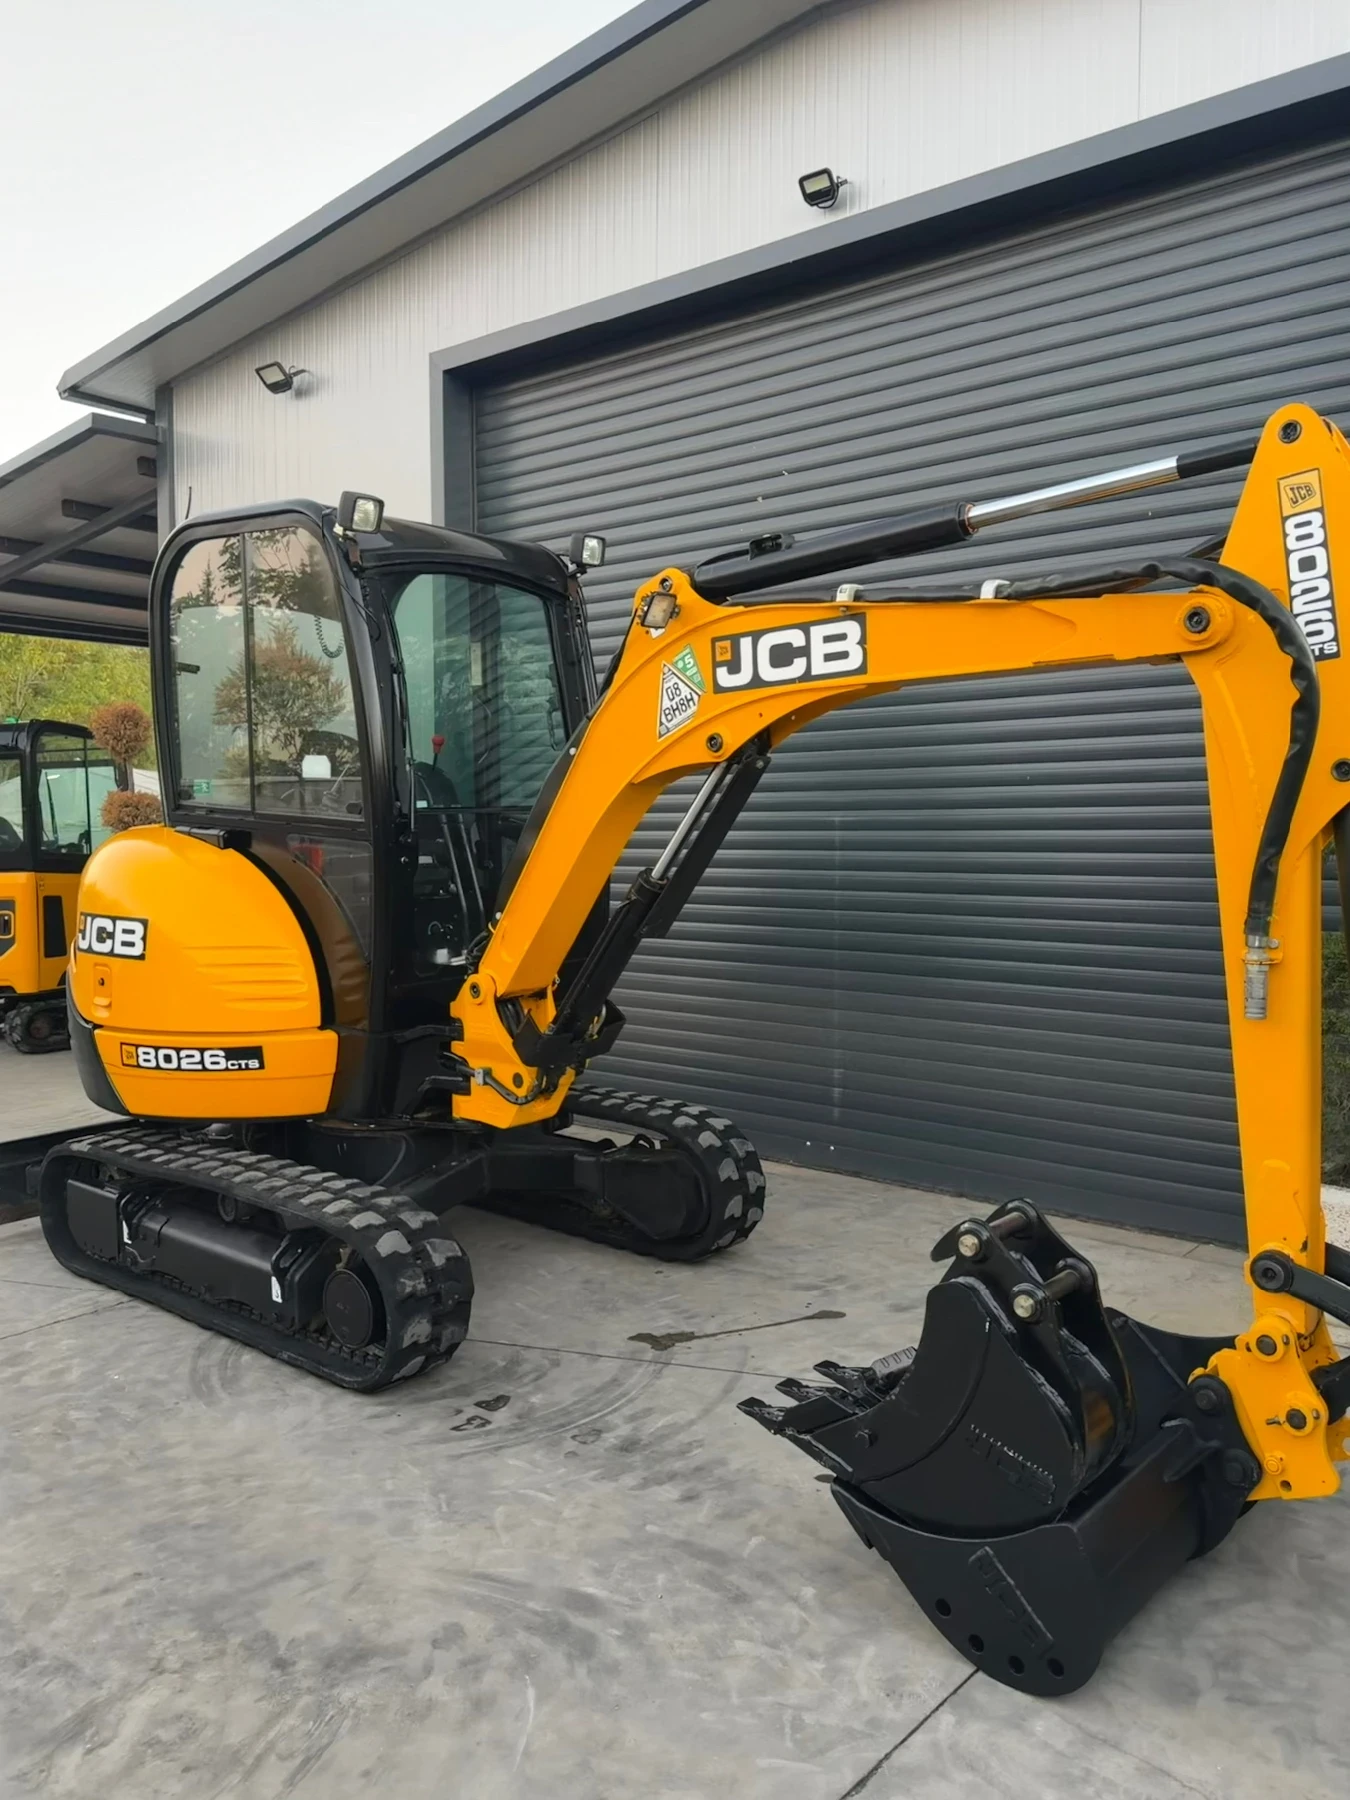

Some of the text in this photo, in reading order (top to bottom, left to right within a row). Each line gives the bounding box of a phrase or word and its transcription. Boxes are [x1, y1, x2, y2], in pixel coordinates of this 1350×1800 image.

[1289, 486, 1313, 505] JCB
[1285, 511, 1335, 645] 8026
[716, 620, 864, 688] JCB
[663, 692, 696, 724] BH8H
[78, 916, 144, 957] JCB
